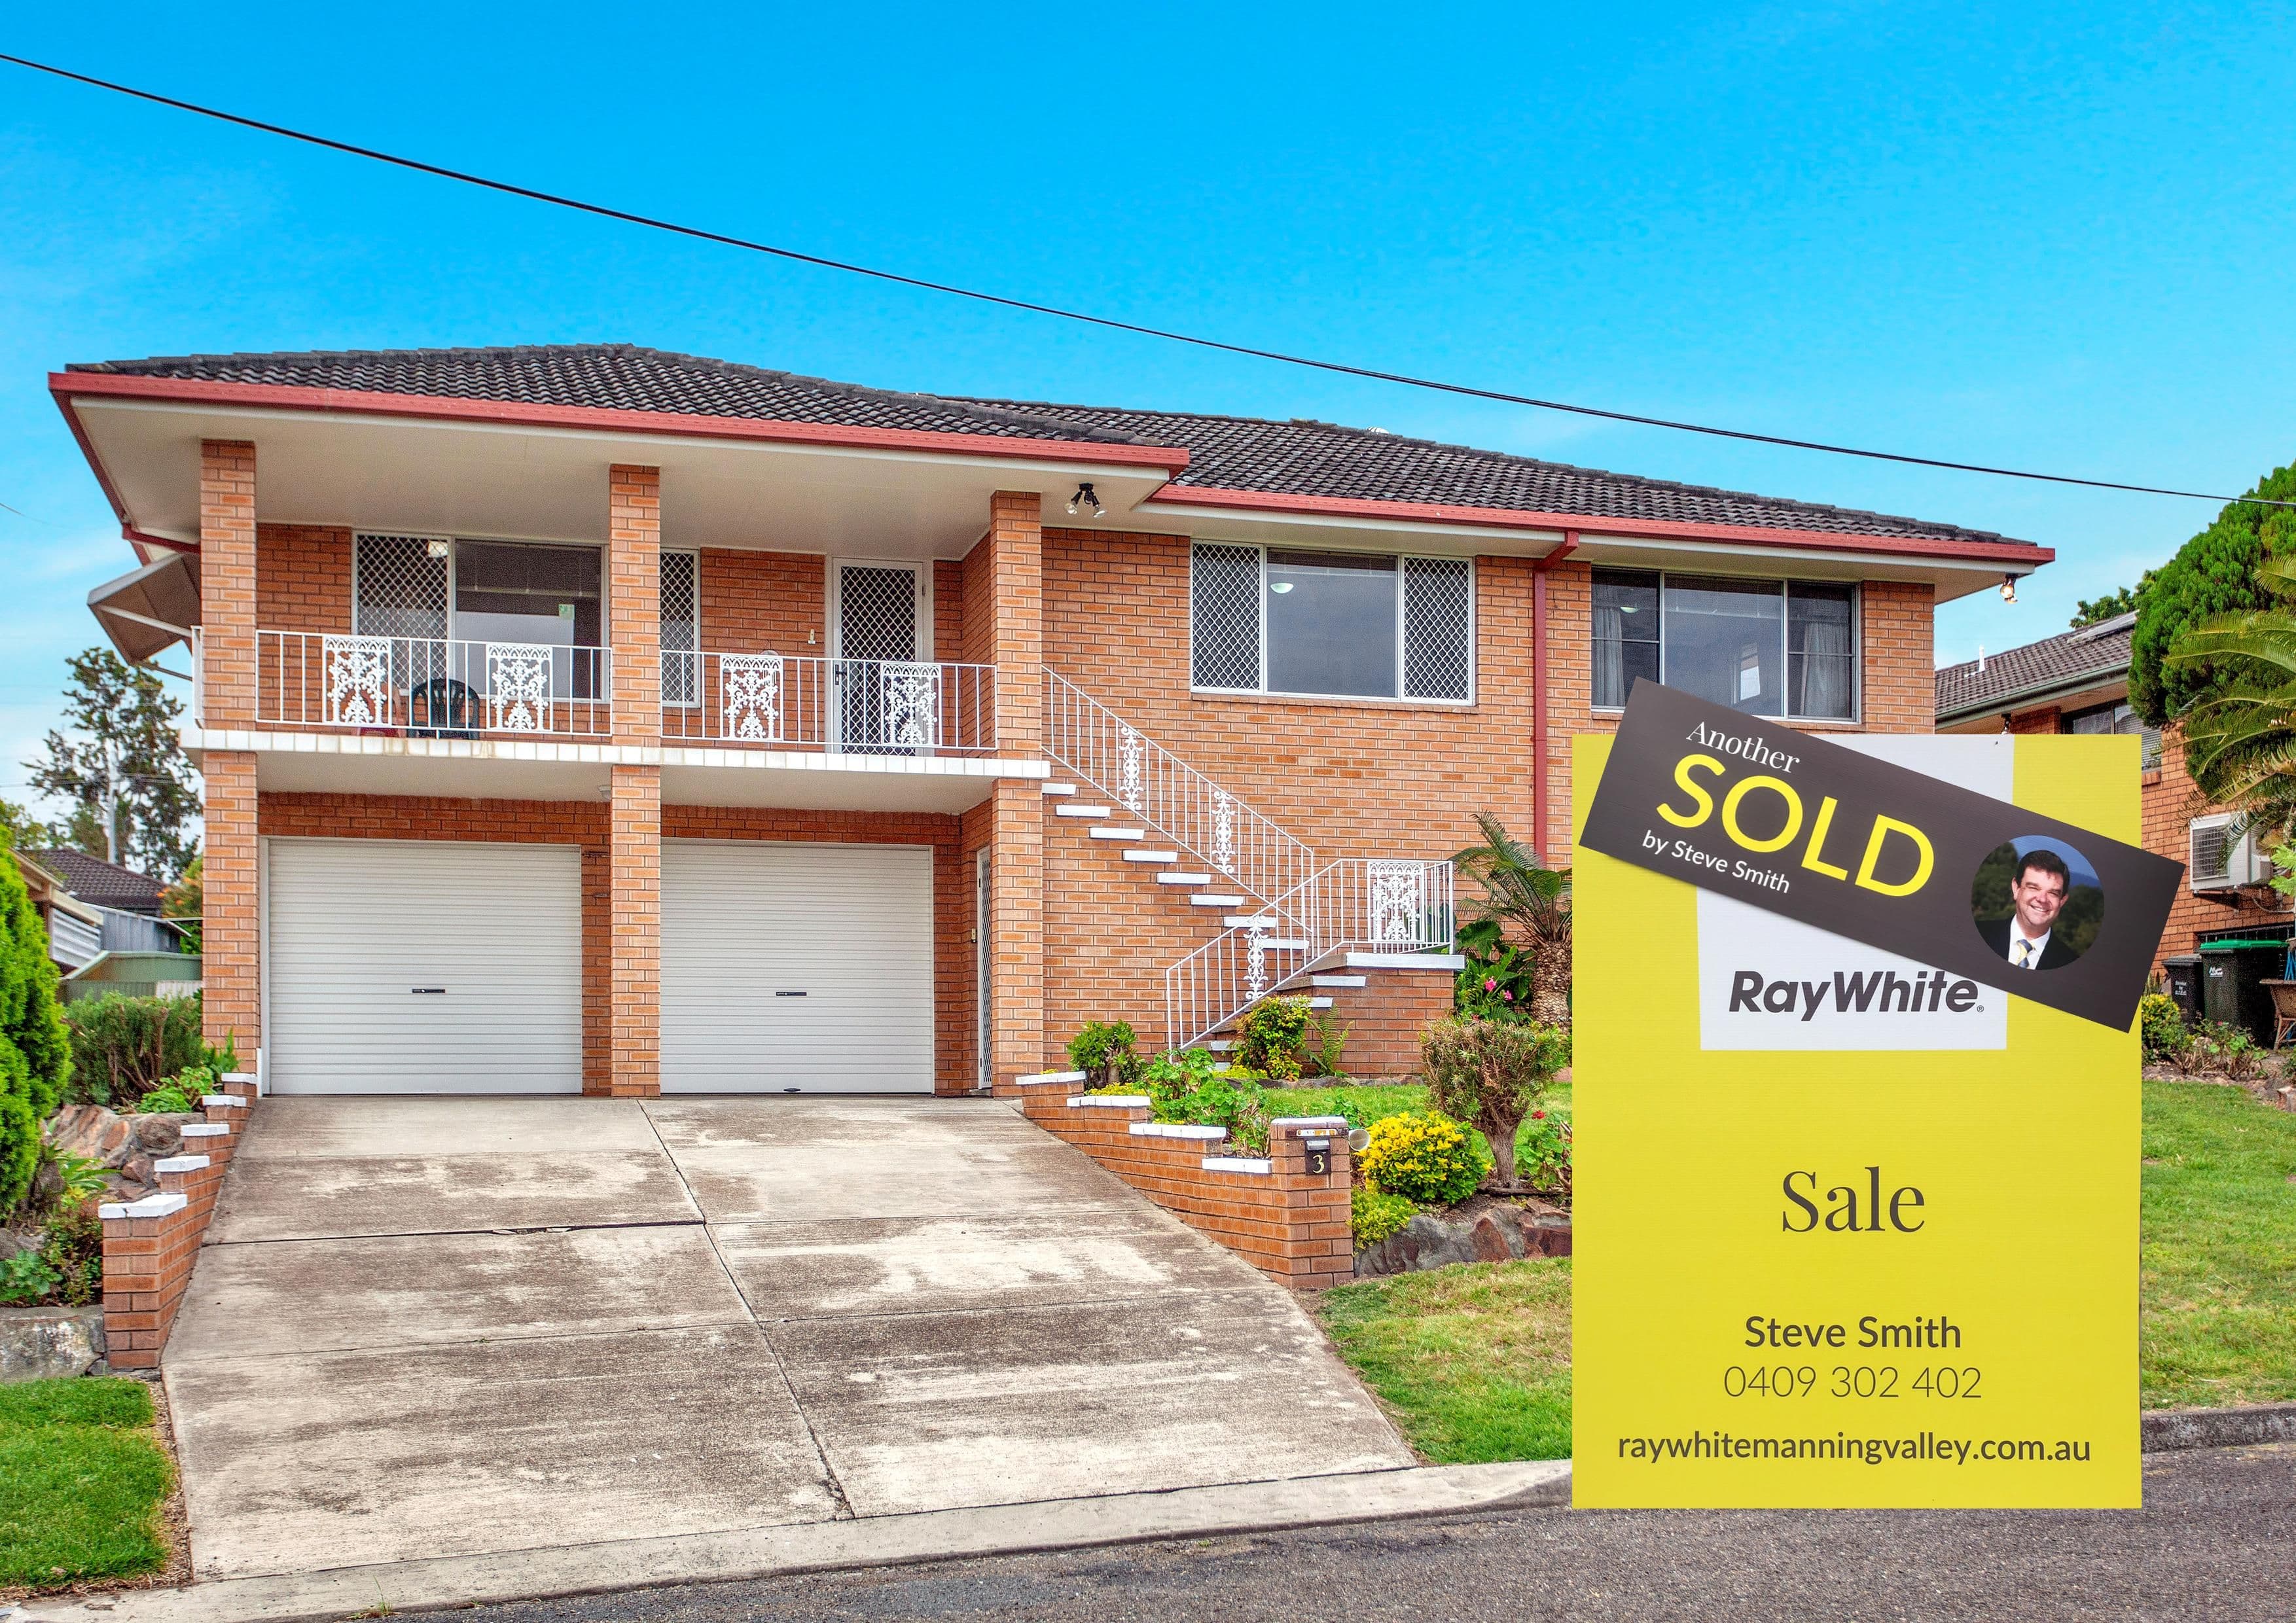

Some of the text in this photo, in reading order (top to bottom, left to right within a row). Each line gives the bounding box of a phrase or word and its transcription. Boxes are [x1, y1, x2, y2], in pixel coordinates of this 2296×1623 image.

[1685, 721, 1801, 774] Another
[1656, 754, 1935, 897] SOLD
[1641, 829, 1790, 894] by Steve Smith
[1313, 1155, 1324, 1173] 3
[1782, 1166, 1925, 1233] Sale
[1744, 1315, 1961, 1348] Steve Smith
[1724, 1366, 1982, 1399] 0409 302 402
[1619, 1431, 2090, 1465] raywhitemanningvalley.com.au
